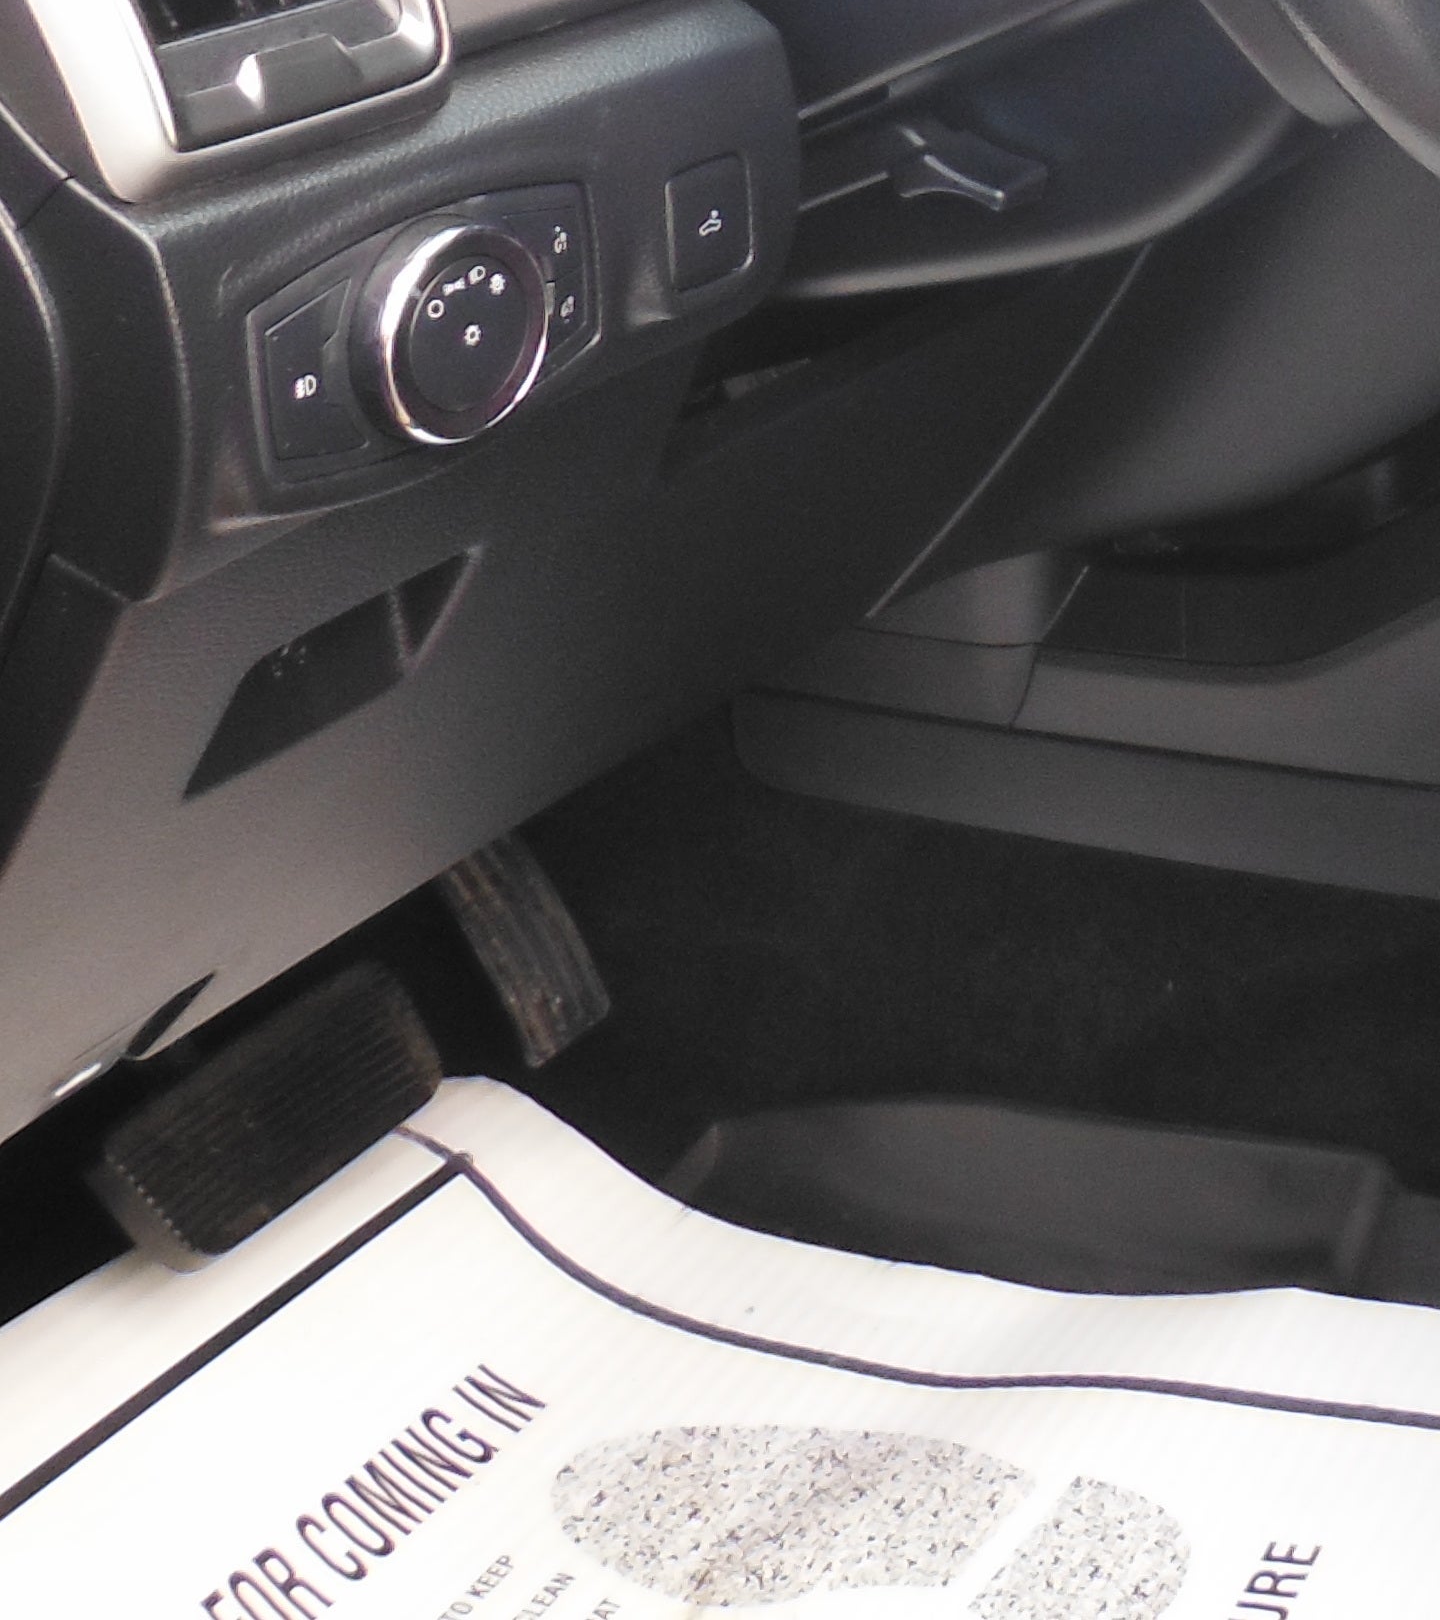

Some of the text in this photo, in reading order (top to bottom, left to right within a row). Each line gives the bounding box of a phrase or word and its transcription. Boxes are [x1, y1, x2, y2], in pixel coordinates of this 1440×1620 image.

[294, 1407, 500, 1581] COMING
[452, 1363, 547, 1433] IN
[465, 1554, 514, 1599] KEEP
